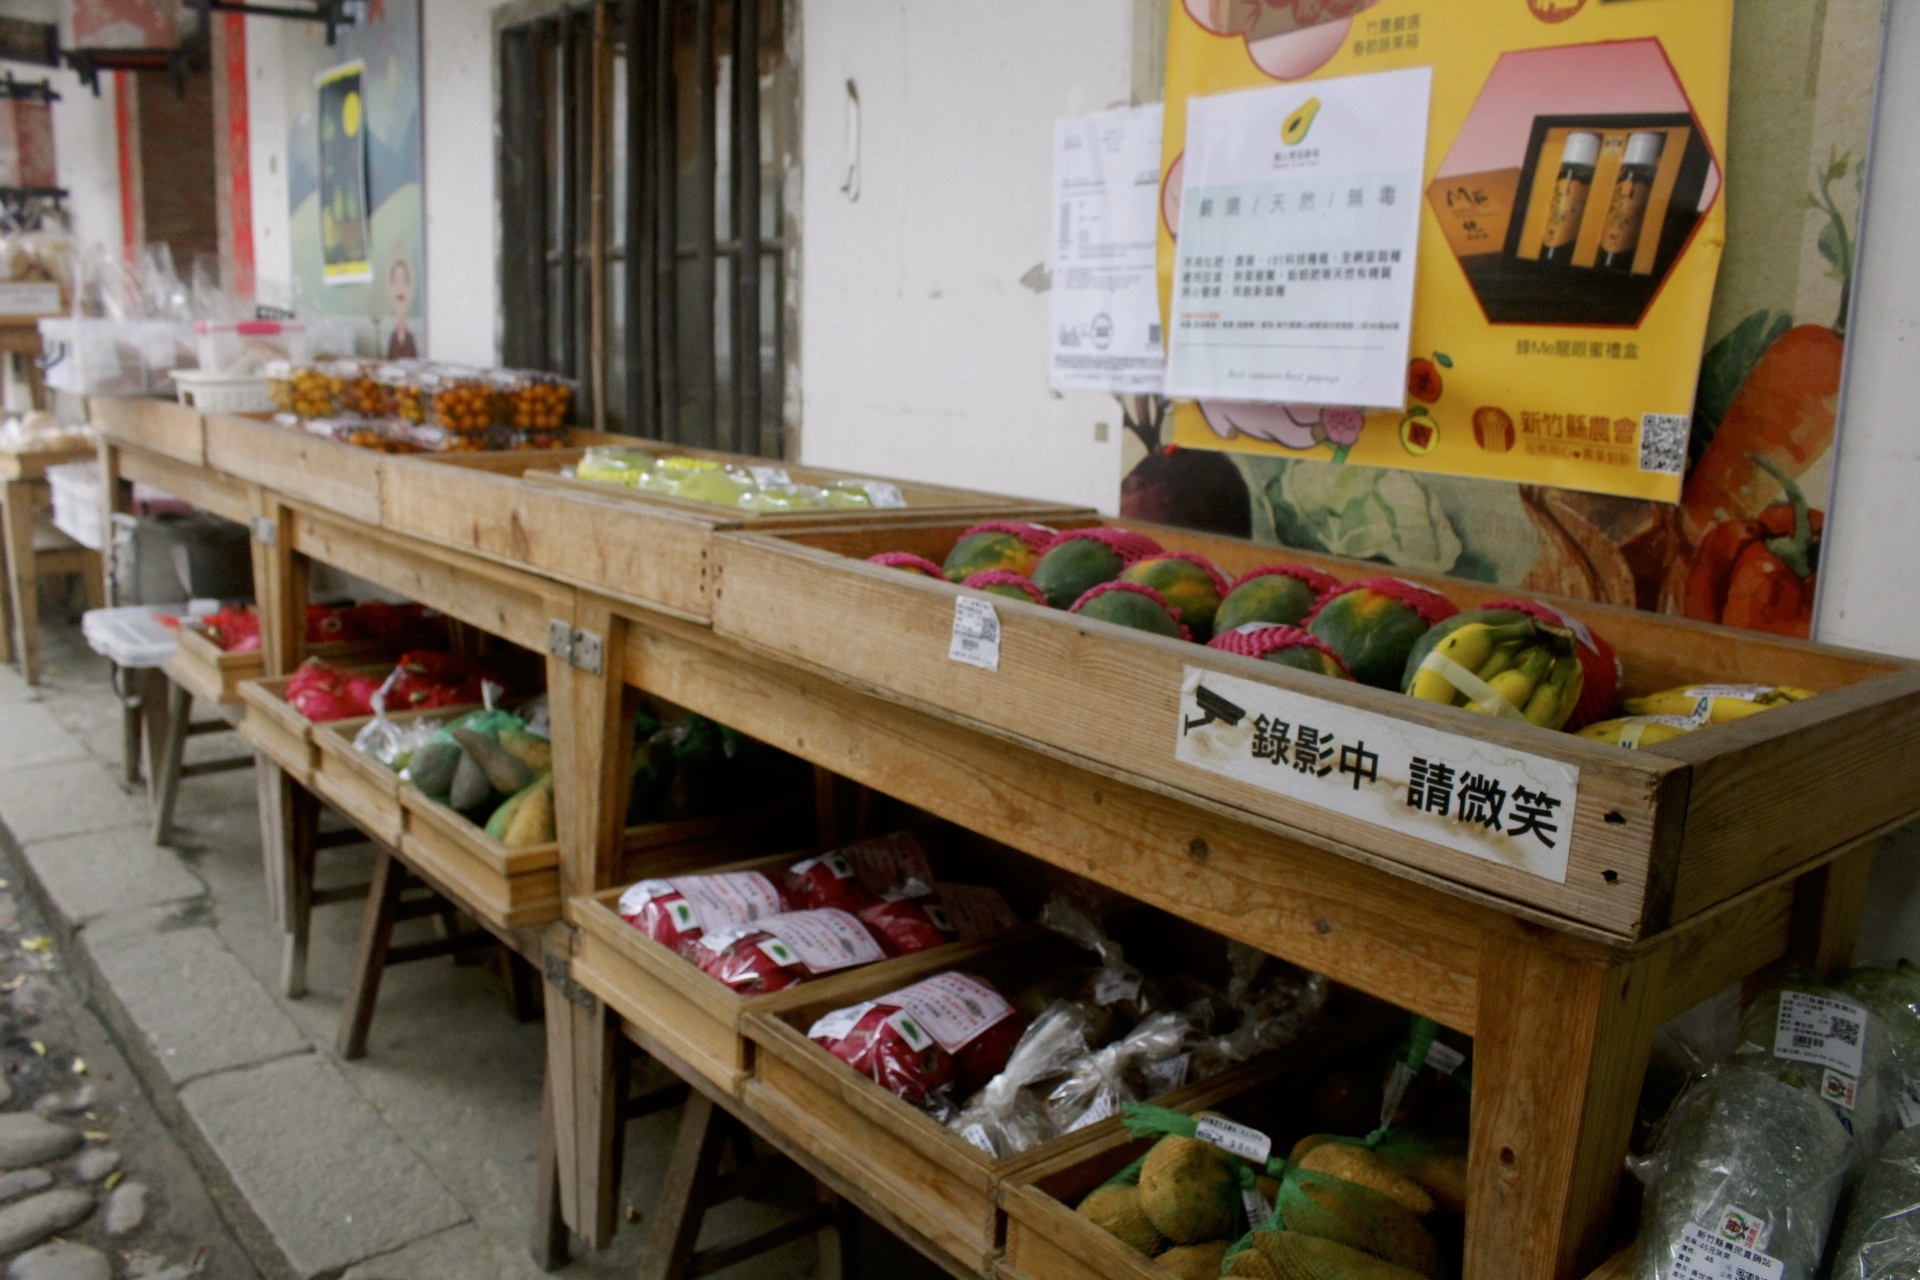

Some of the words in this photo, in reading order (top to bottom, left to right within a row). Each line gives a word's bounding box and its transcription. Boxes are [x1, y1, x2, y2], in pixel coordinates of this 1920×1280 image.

[1520, 410, 1638, 445] 新竹縣農會
[1251, 713, 1379, 791] 錄影中
[1406, 756, 1562, 849] 請微笑
[1697, 1229, 1772, 1269] 新竹縣農民直銷站
[1705, 1255, 1715, 1264] 45
